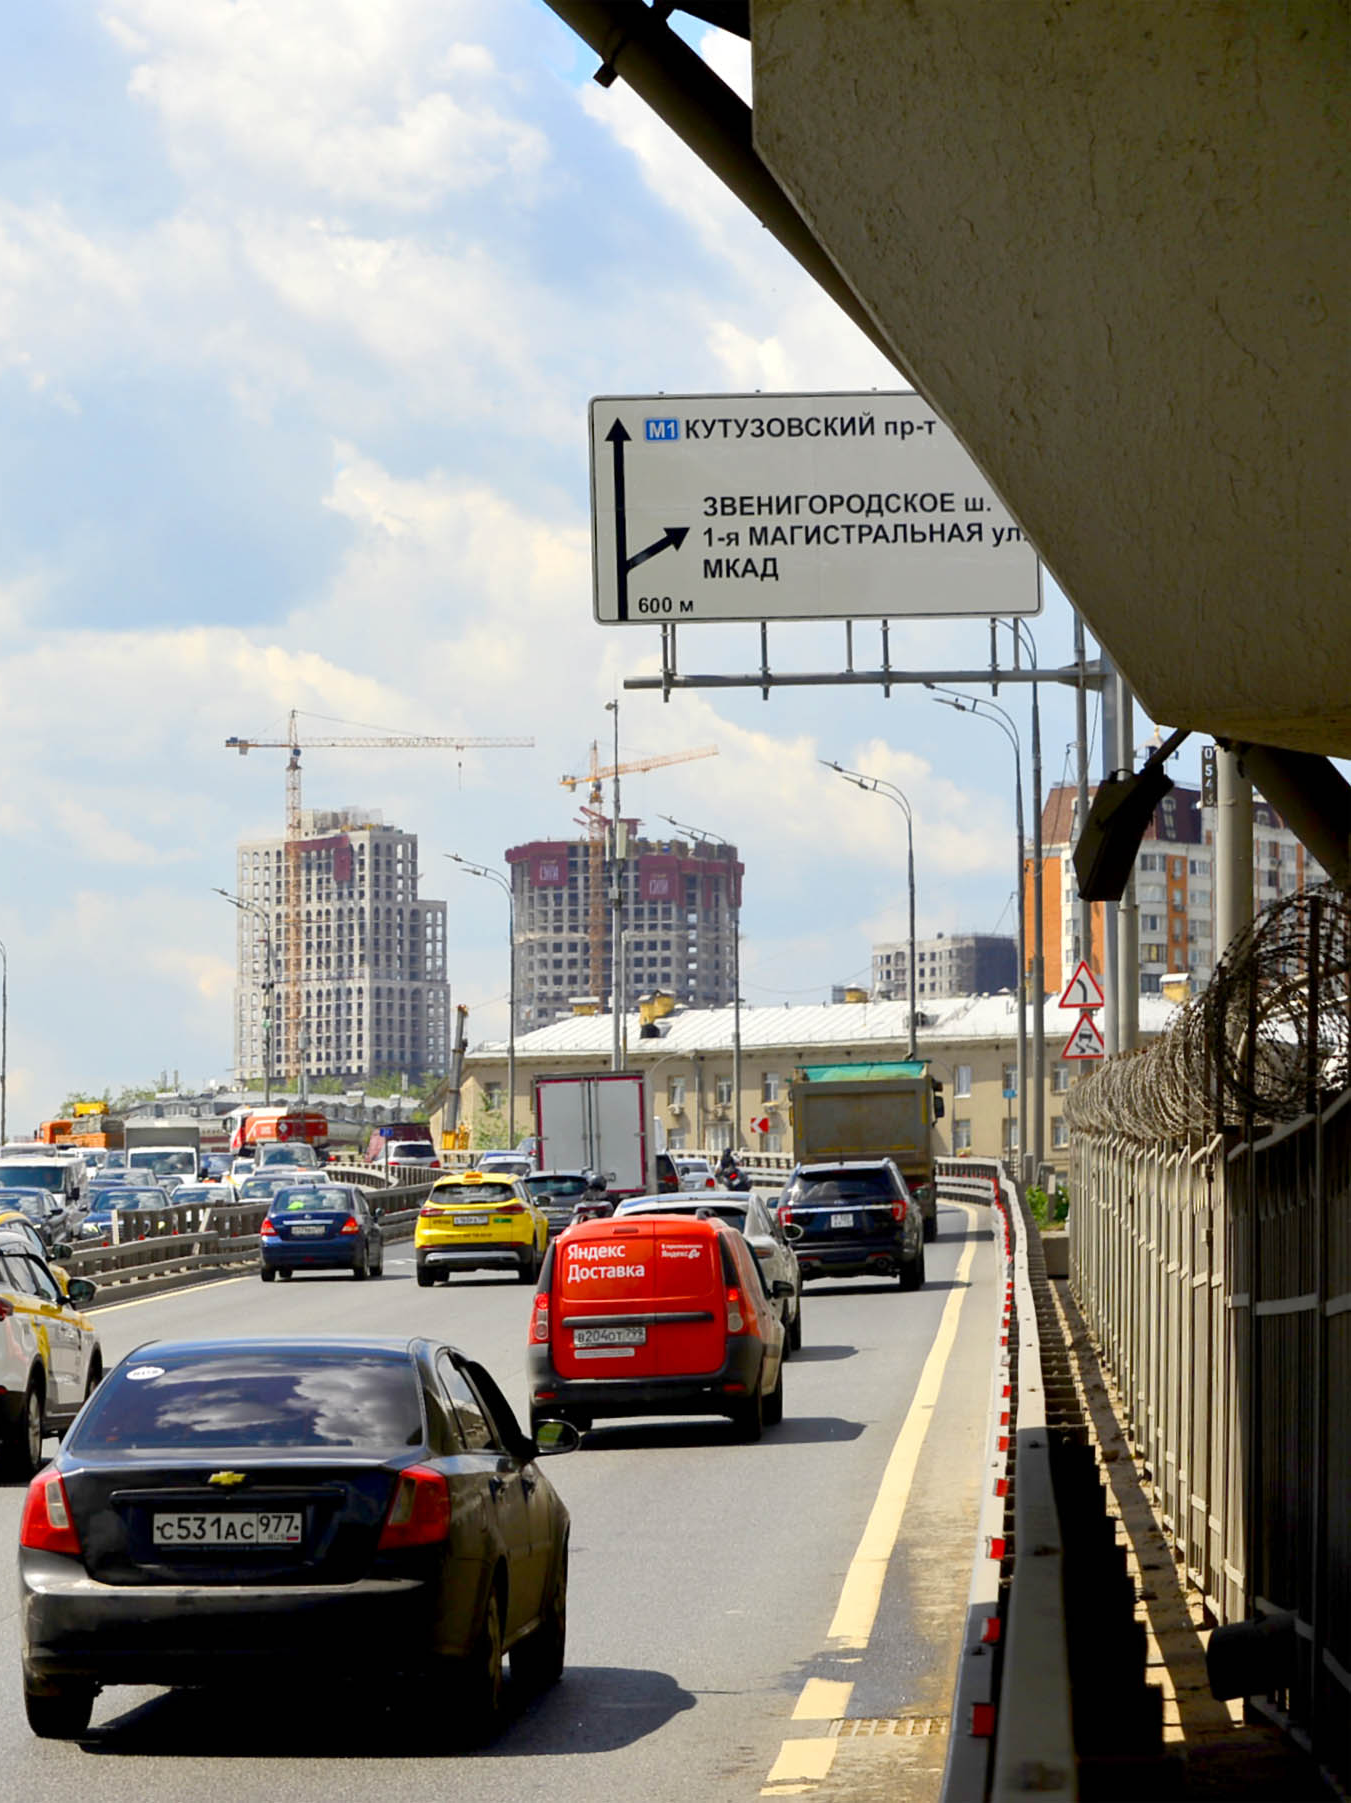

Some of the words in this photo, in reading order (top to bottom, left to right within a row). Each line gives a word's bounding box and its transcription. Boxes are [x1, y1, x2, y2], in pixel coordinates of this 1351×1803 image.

[685, 412, 875, 439] КУТУЗОВСКИЙ
[884, 421, 937, 440] пр-т
[703, 493, 954, 518] ЗВЕНИГОРОДСКОЕ
[964, 497, 992, 512] ш.
[703, 527, 739, 547] 1-я
[749, 522, 983, 546] МАГИСТРАЛЬНАЯ
[703, 557, 779, 581] МКАД
[638, 597, 672, 614] 600
[680, 599, 694, 613] м
[567, 1244, 626, 1262] Яндекс
[567, 1264, 646, 1284] Доставка
